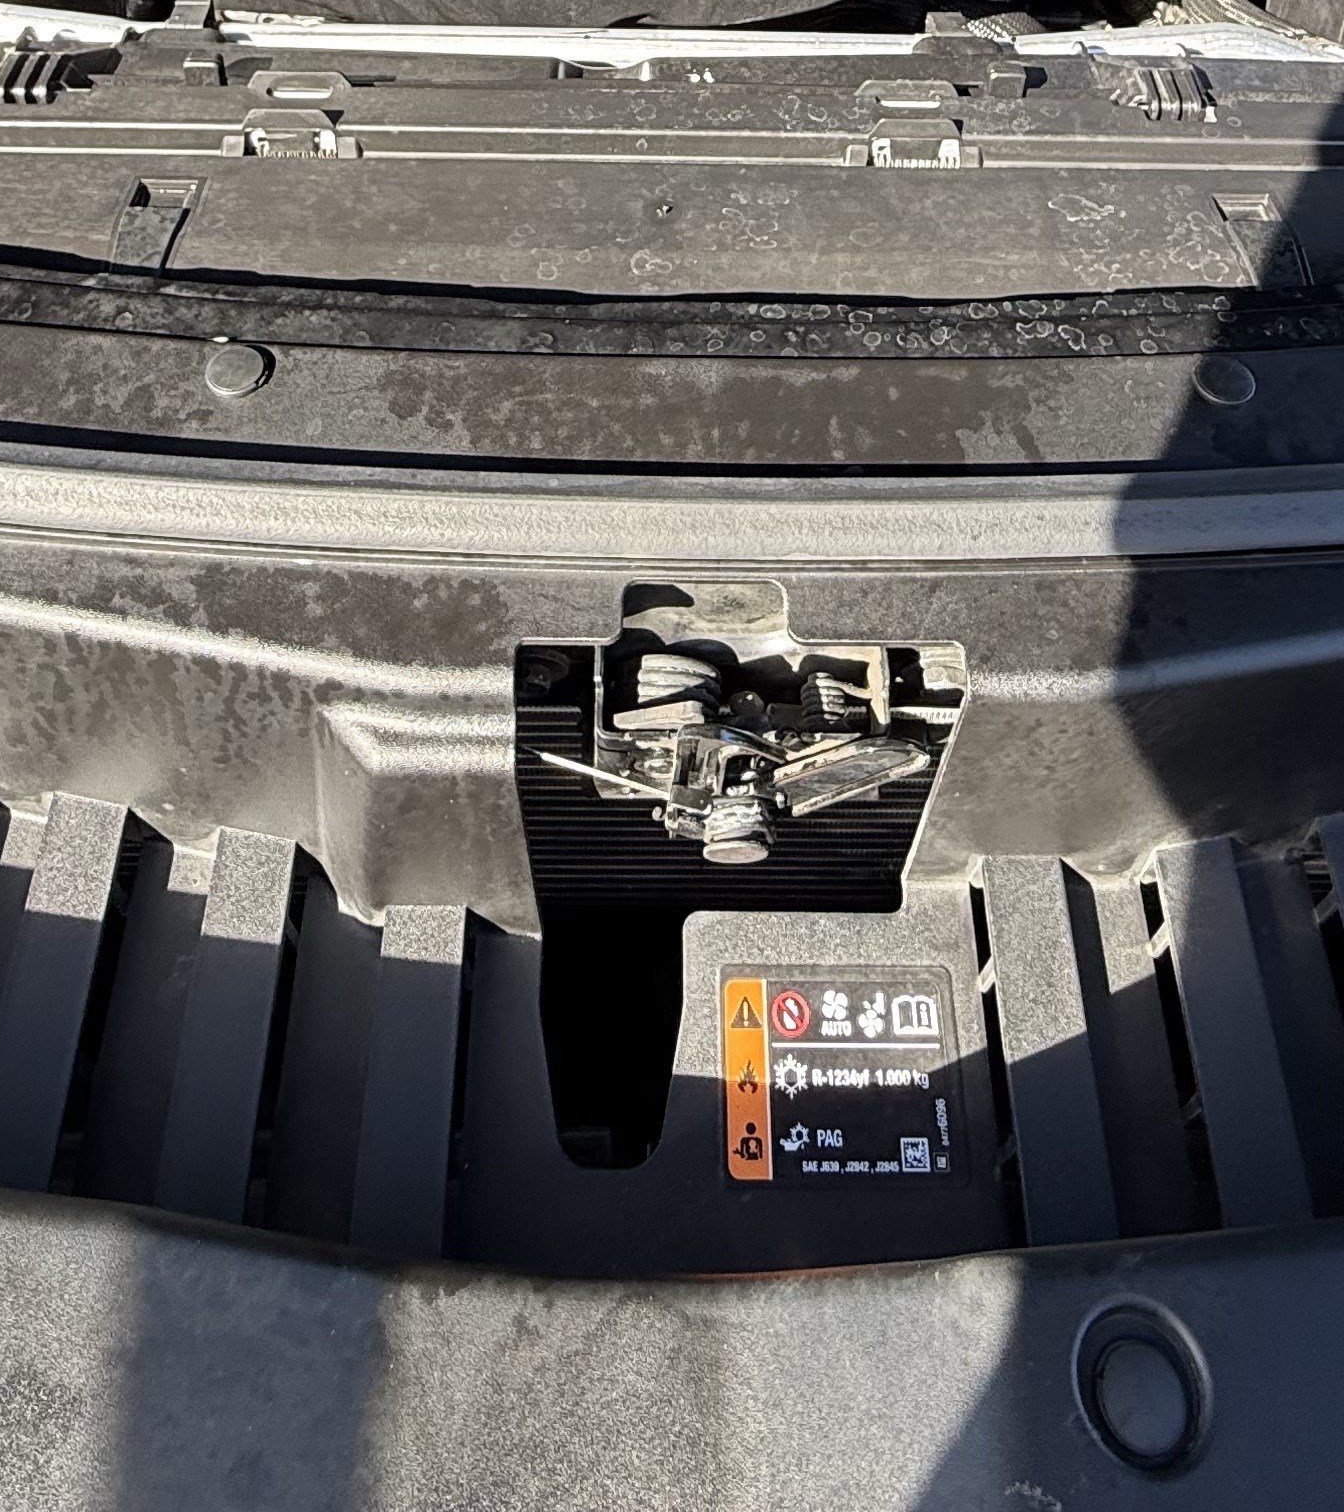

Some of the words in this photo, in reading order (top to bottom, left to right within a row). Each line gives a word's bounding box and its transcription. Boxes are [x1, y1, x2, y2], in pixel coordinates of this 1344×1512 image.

[821, 1020, 852, 1037] AUTO
[811, 1068, 870, 1089] R-1234yf
[875, 1068, 912, 1087] 1.000
[912, 1068, 930, 1089] kg
[816, 1129, 843, 1148] PAG
[802, 1160, 819, 1173] SAE
